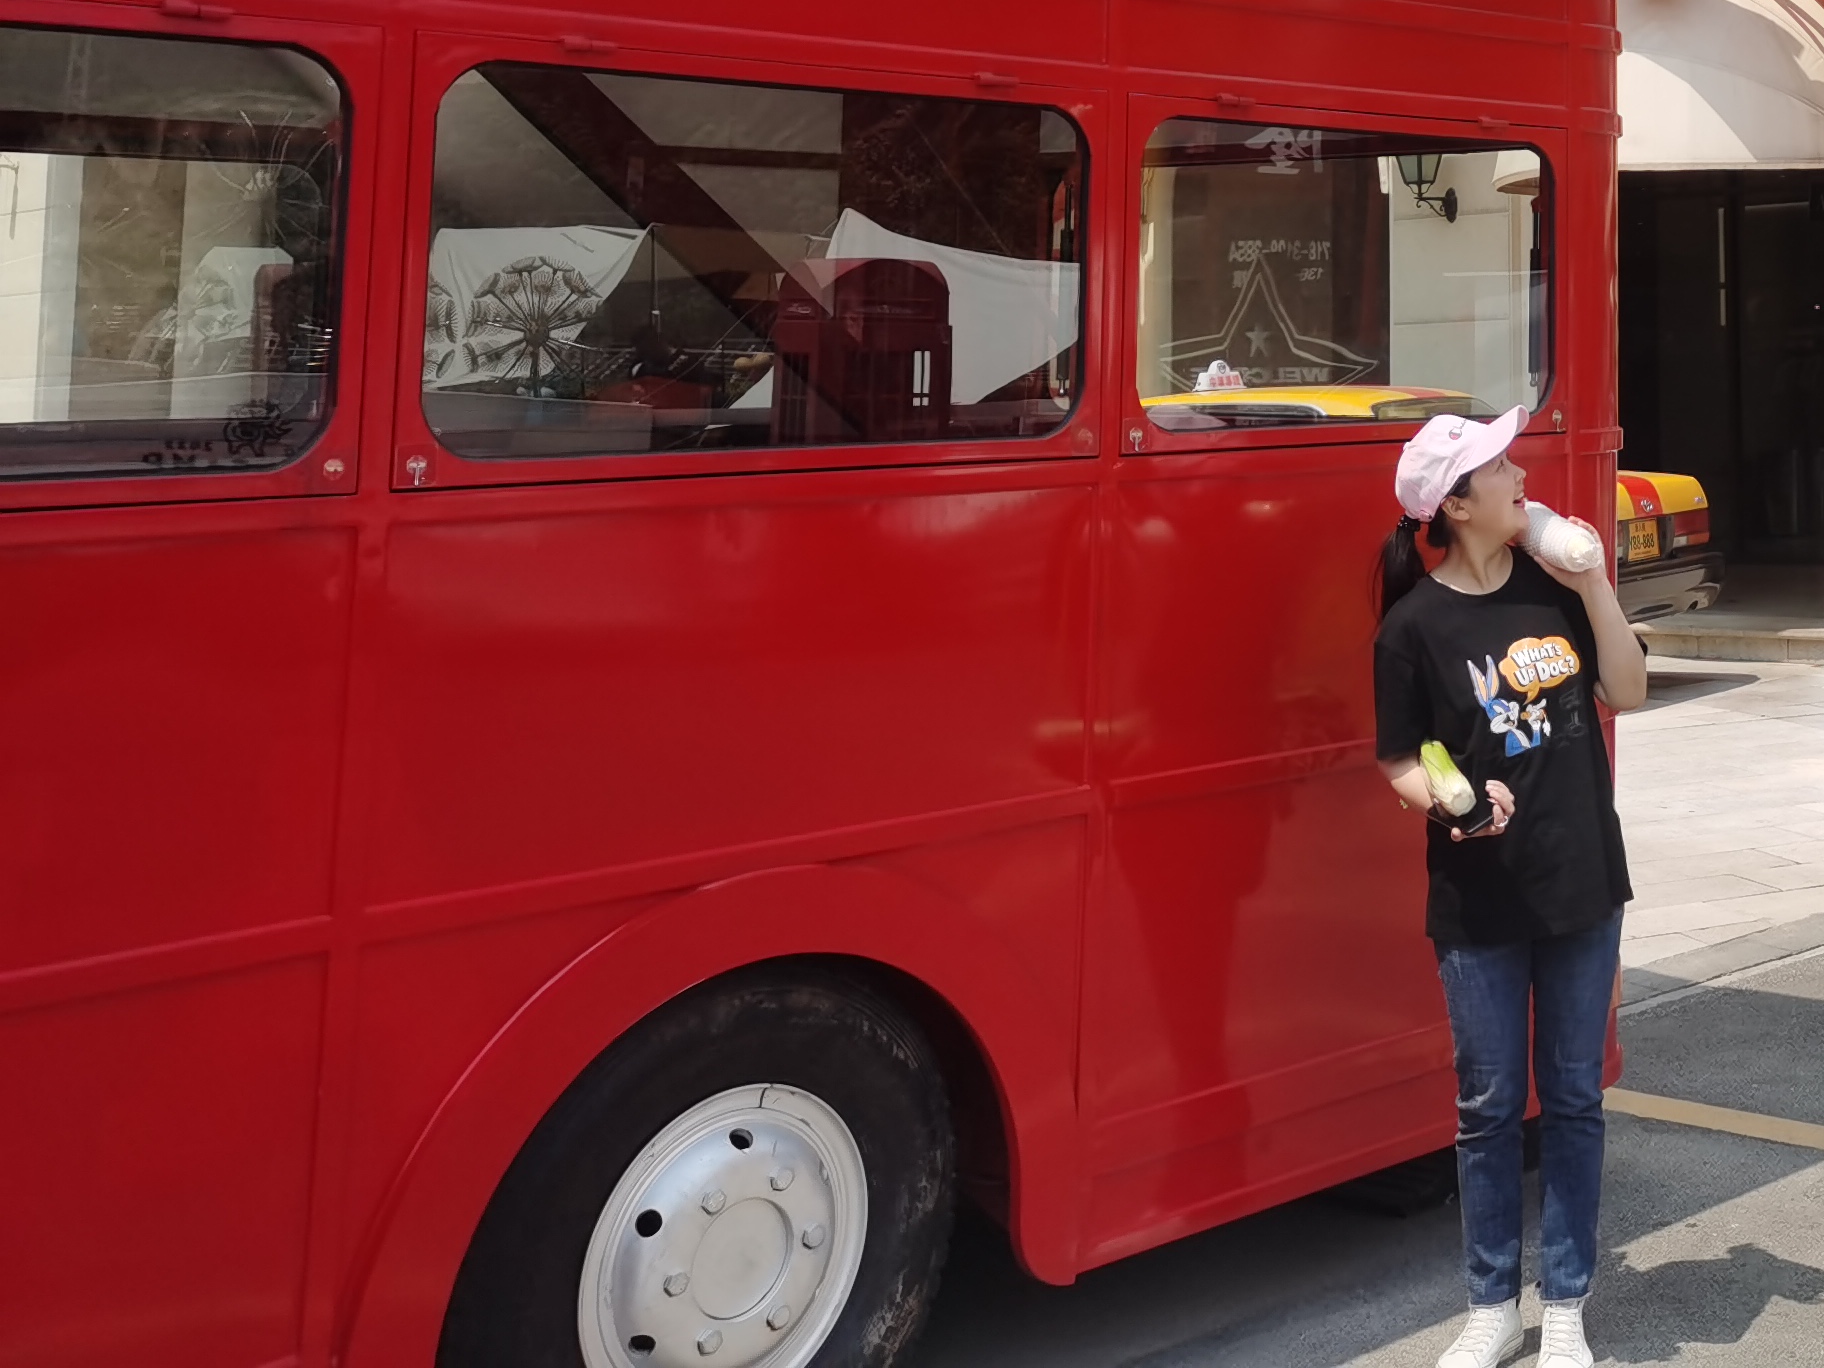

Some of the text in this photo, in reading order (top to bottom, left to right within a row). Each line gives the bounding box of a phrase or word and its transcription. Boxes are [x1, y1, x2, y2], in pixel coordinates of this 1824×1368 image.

[1511, 643, 1562, 668] WHAT'S
[1514, 655, 1575, 687] UP DOC?
